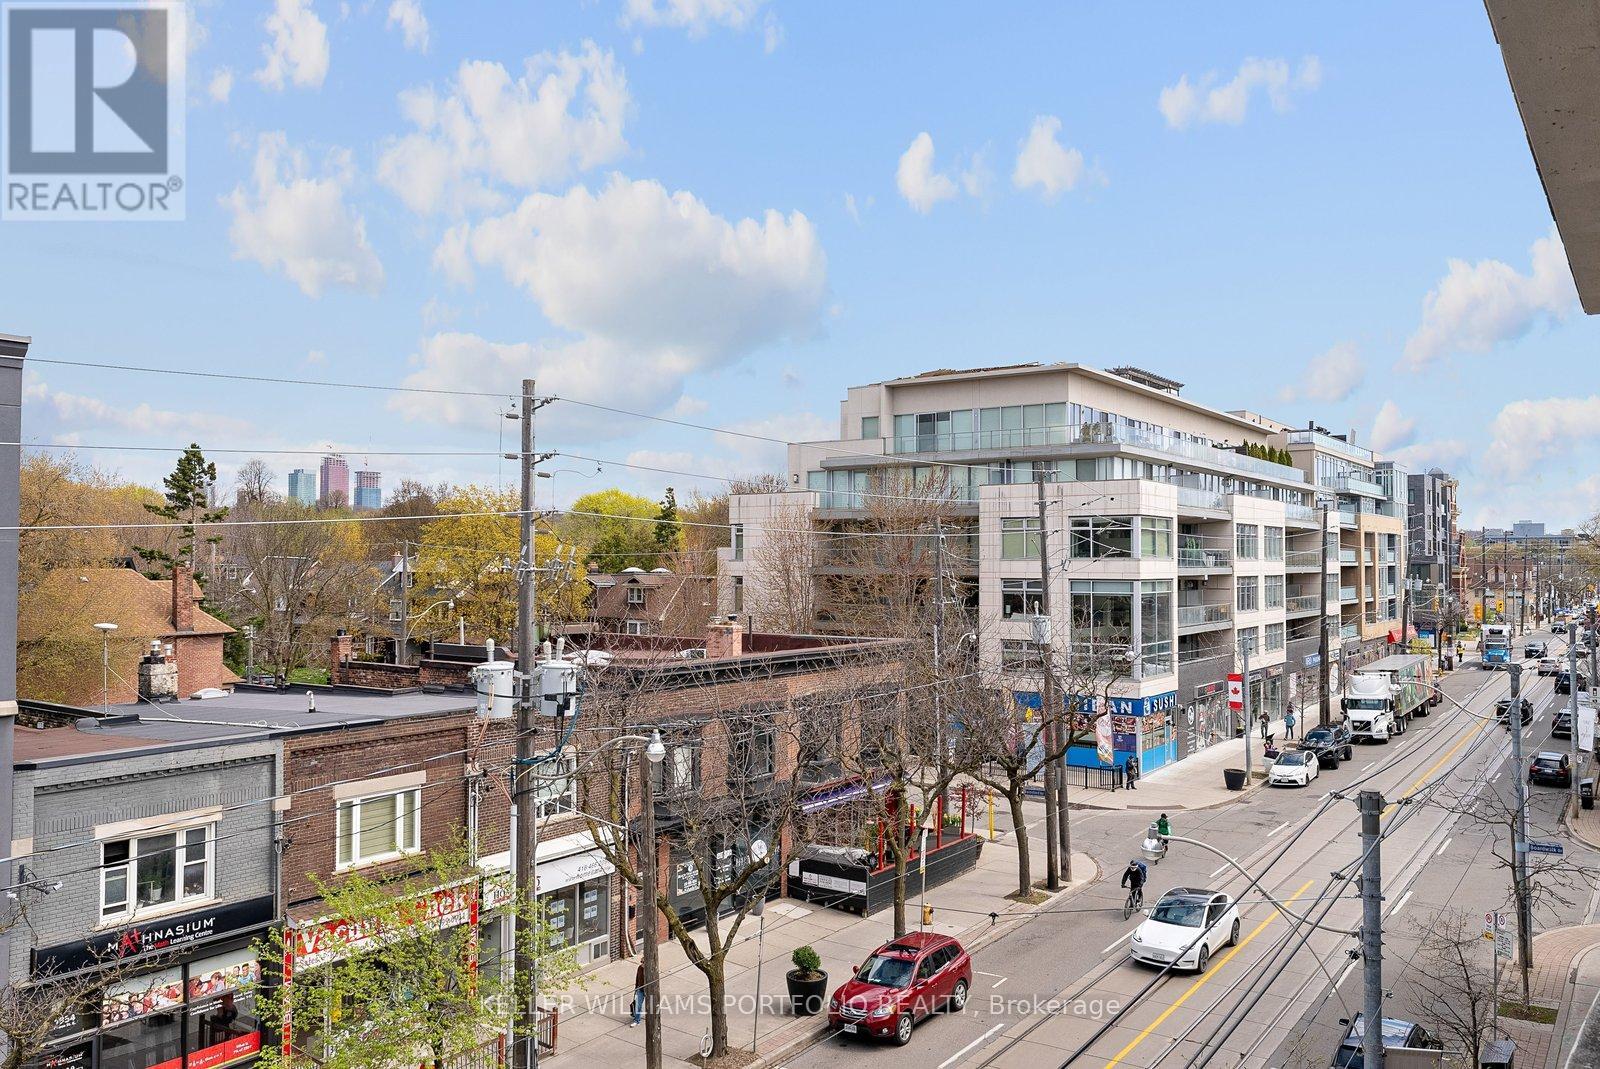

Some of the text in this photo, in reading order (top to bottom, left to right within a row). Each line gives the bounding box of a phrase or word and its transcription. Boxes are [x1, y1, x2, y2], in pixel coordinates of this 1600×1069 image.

[1153, 693, 1177, 712] SUSHI
[170, 934, 194, 945] Learning
[194, 929, 213, 939] Centre
